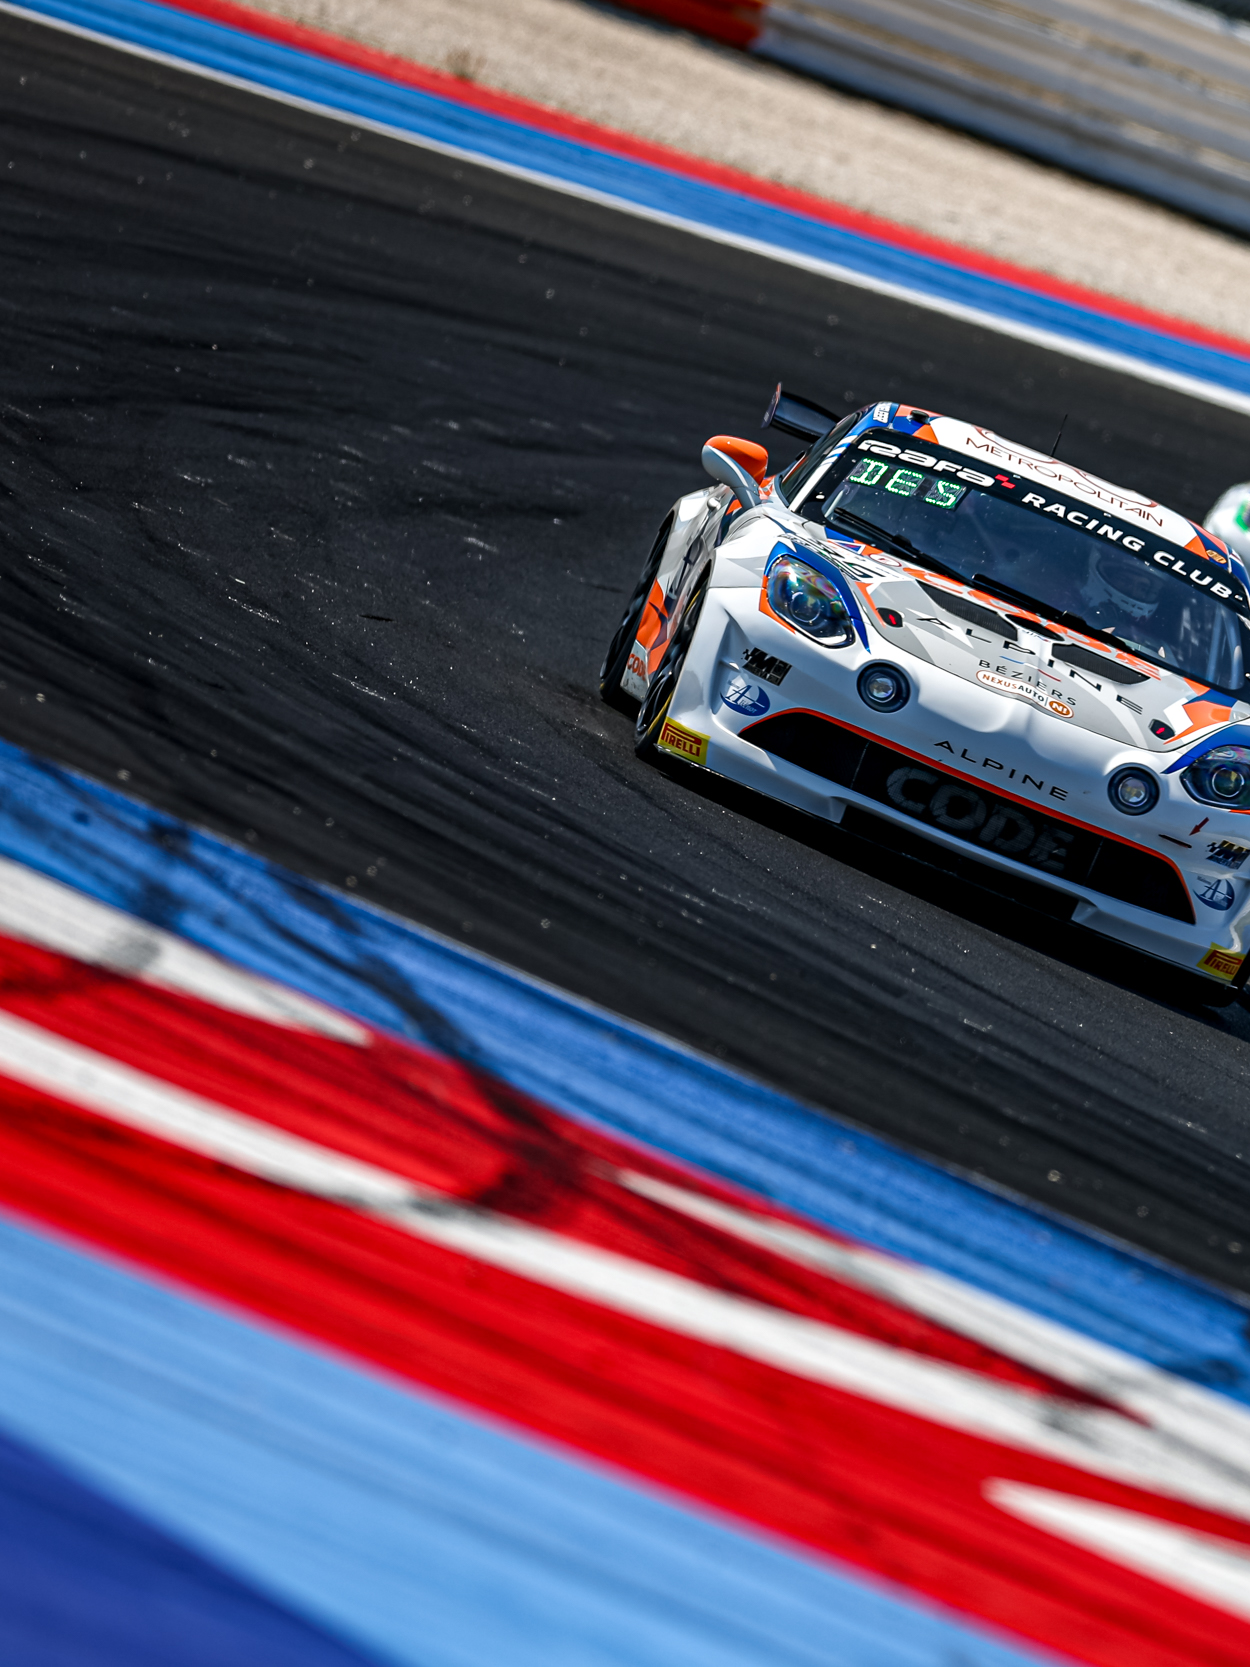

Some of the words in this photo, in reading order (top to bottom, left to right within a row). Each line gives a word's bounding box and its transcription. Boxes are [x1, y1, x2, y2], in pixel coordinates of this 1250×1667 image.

[849, 457, 961, 508] DES
[966, 437, 1163, 527] METROPOLITAN
[1022, 492, 1145, 552] RACING
[1153, 551, 1232, 598] CLUB
[917, 617, 1143, 715] ALPINE
[979, 659, 1077, 706] BÉZIERS
[661, 722, 702, 757] PIRELLI
[934, 740, 1069, 801] ALPINE
[886, 766, 1075, 873] CODE
